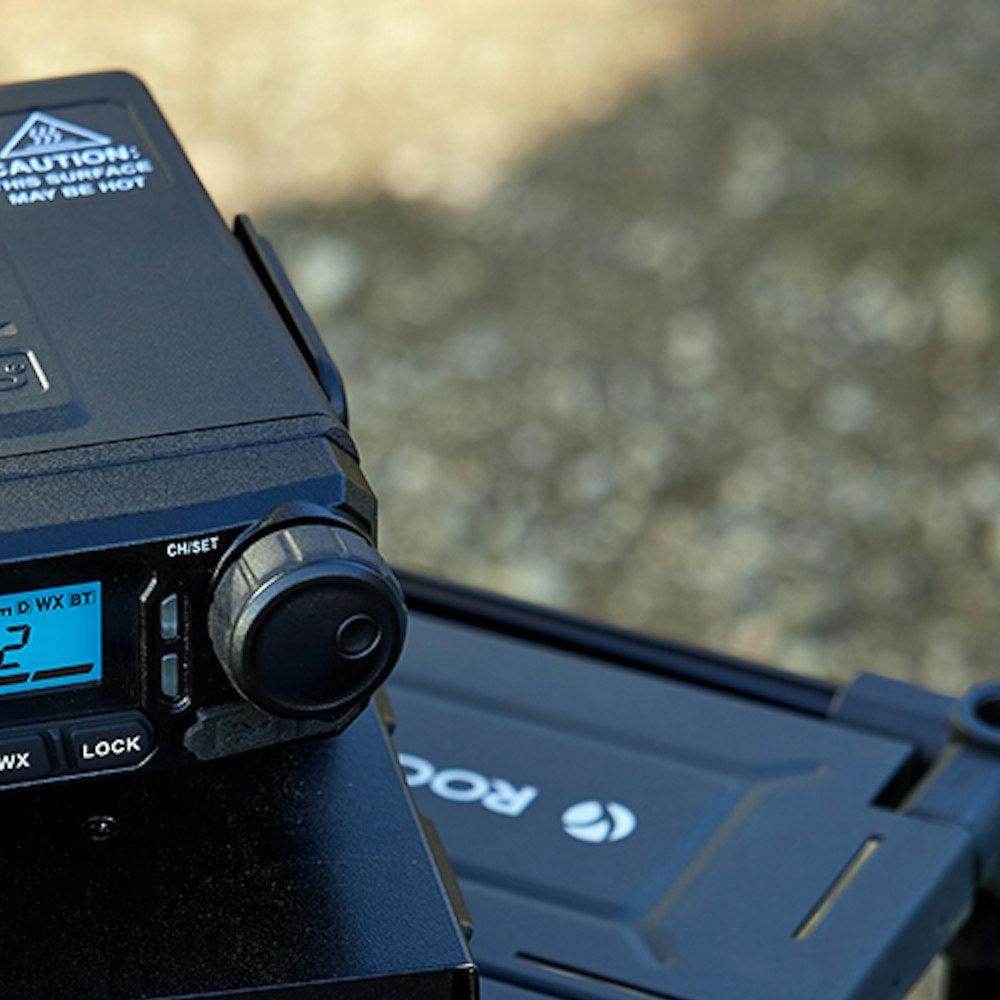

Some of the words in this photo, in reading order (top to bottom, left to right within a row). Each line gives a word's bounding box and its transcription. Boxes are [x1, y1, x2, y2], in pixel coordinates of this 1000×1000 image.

[44, 159, 153, 186] SURFACE
[8, 188, 57, 206] MAY
[61, 182, 96, 199] BE
[99, 175, 147, 193] HOT
[166, 536, 220, 558] CH/SET
[35, 594, 64, 612] WX
[71, 591, 93, 606] BT
[82, 735, 142, 759] LOCK
